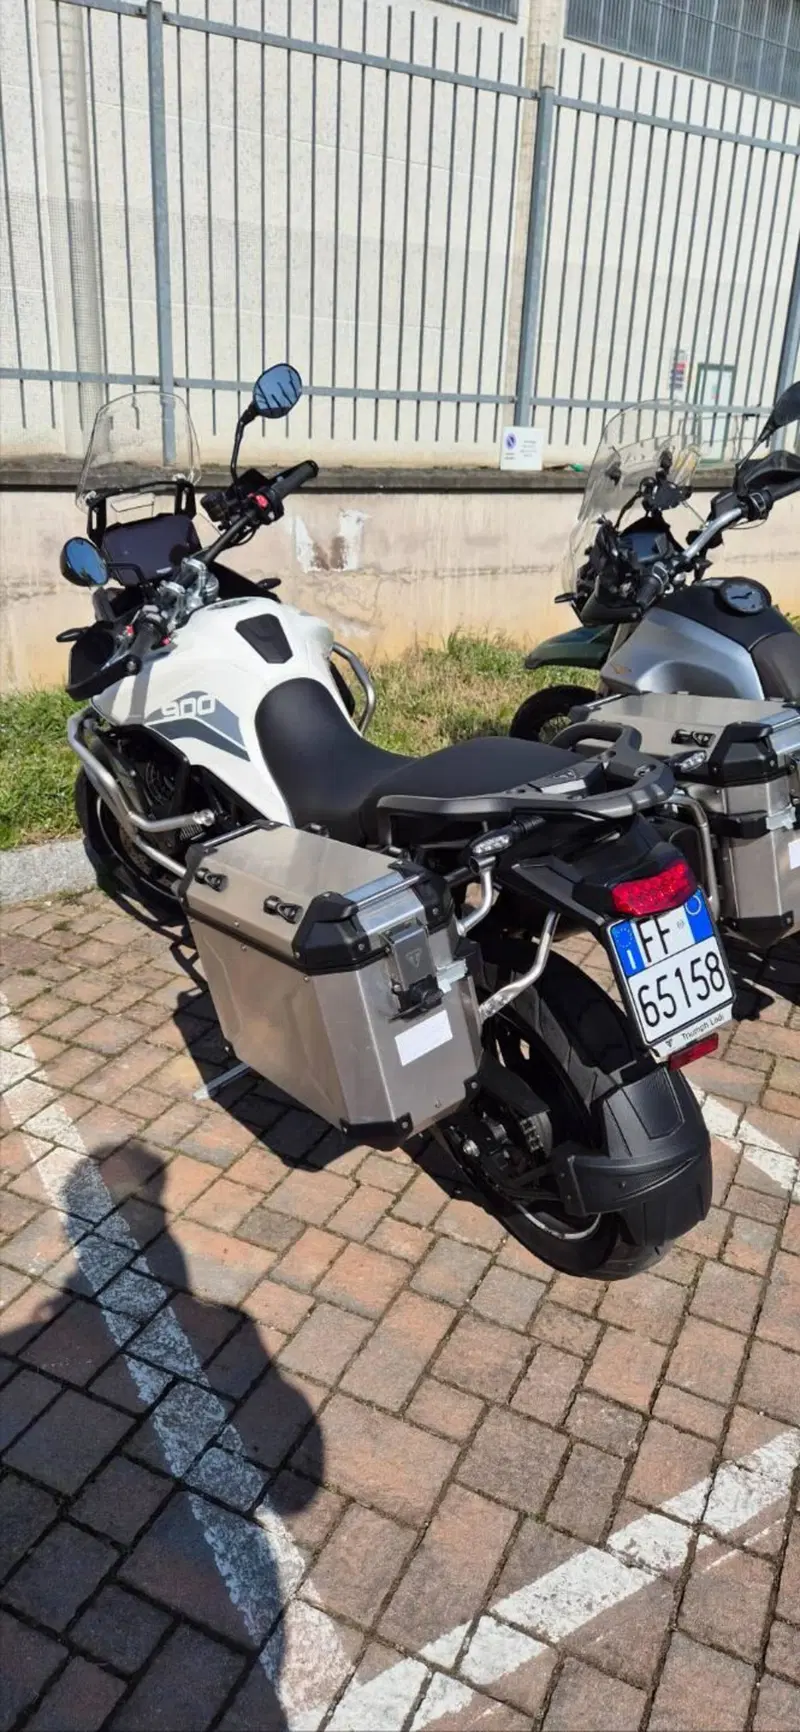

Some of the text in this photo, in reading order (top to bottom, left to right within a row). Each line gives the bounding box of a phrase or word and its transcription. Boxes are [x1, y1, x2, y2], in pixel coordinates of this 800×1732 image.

[162, 694, 216, 717] 900
[637, 917, 671, 963] FF
[638, 951, 725, 1027] 65158
[681, 1021, 709, 1041] Triumph
